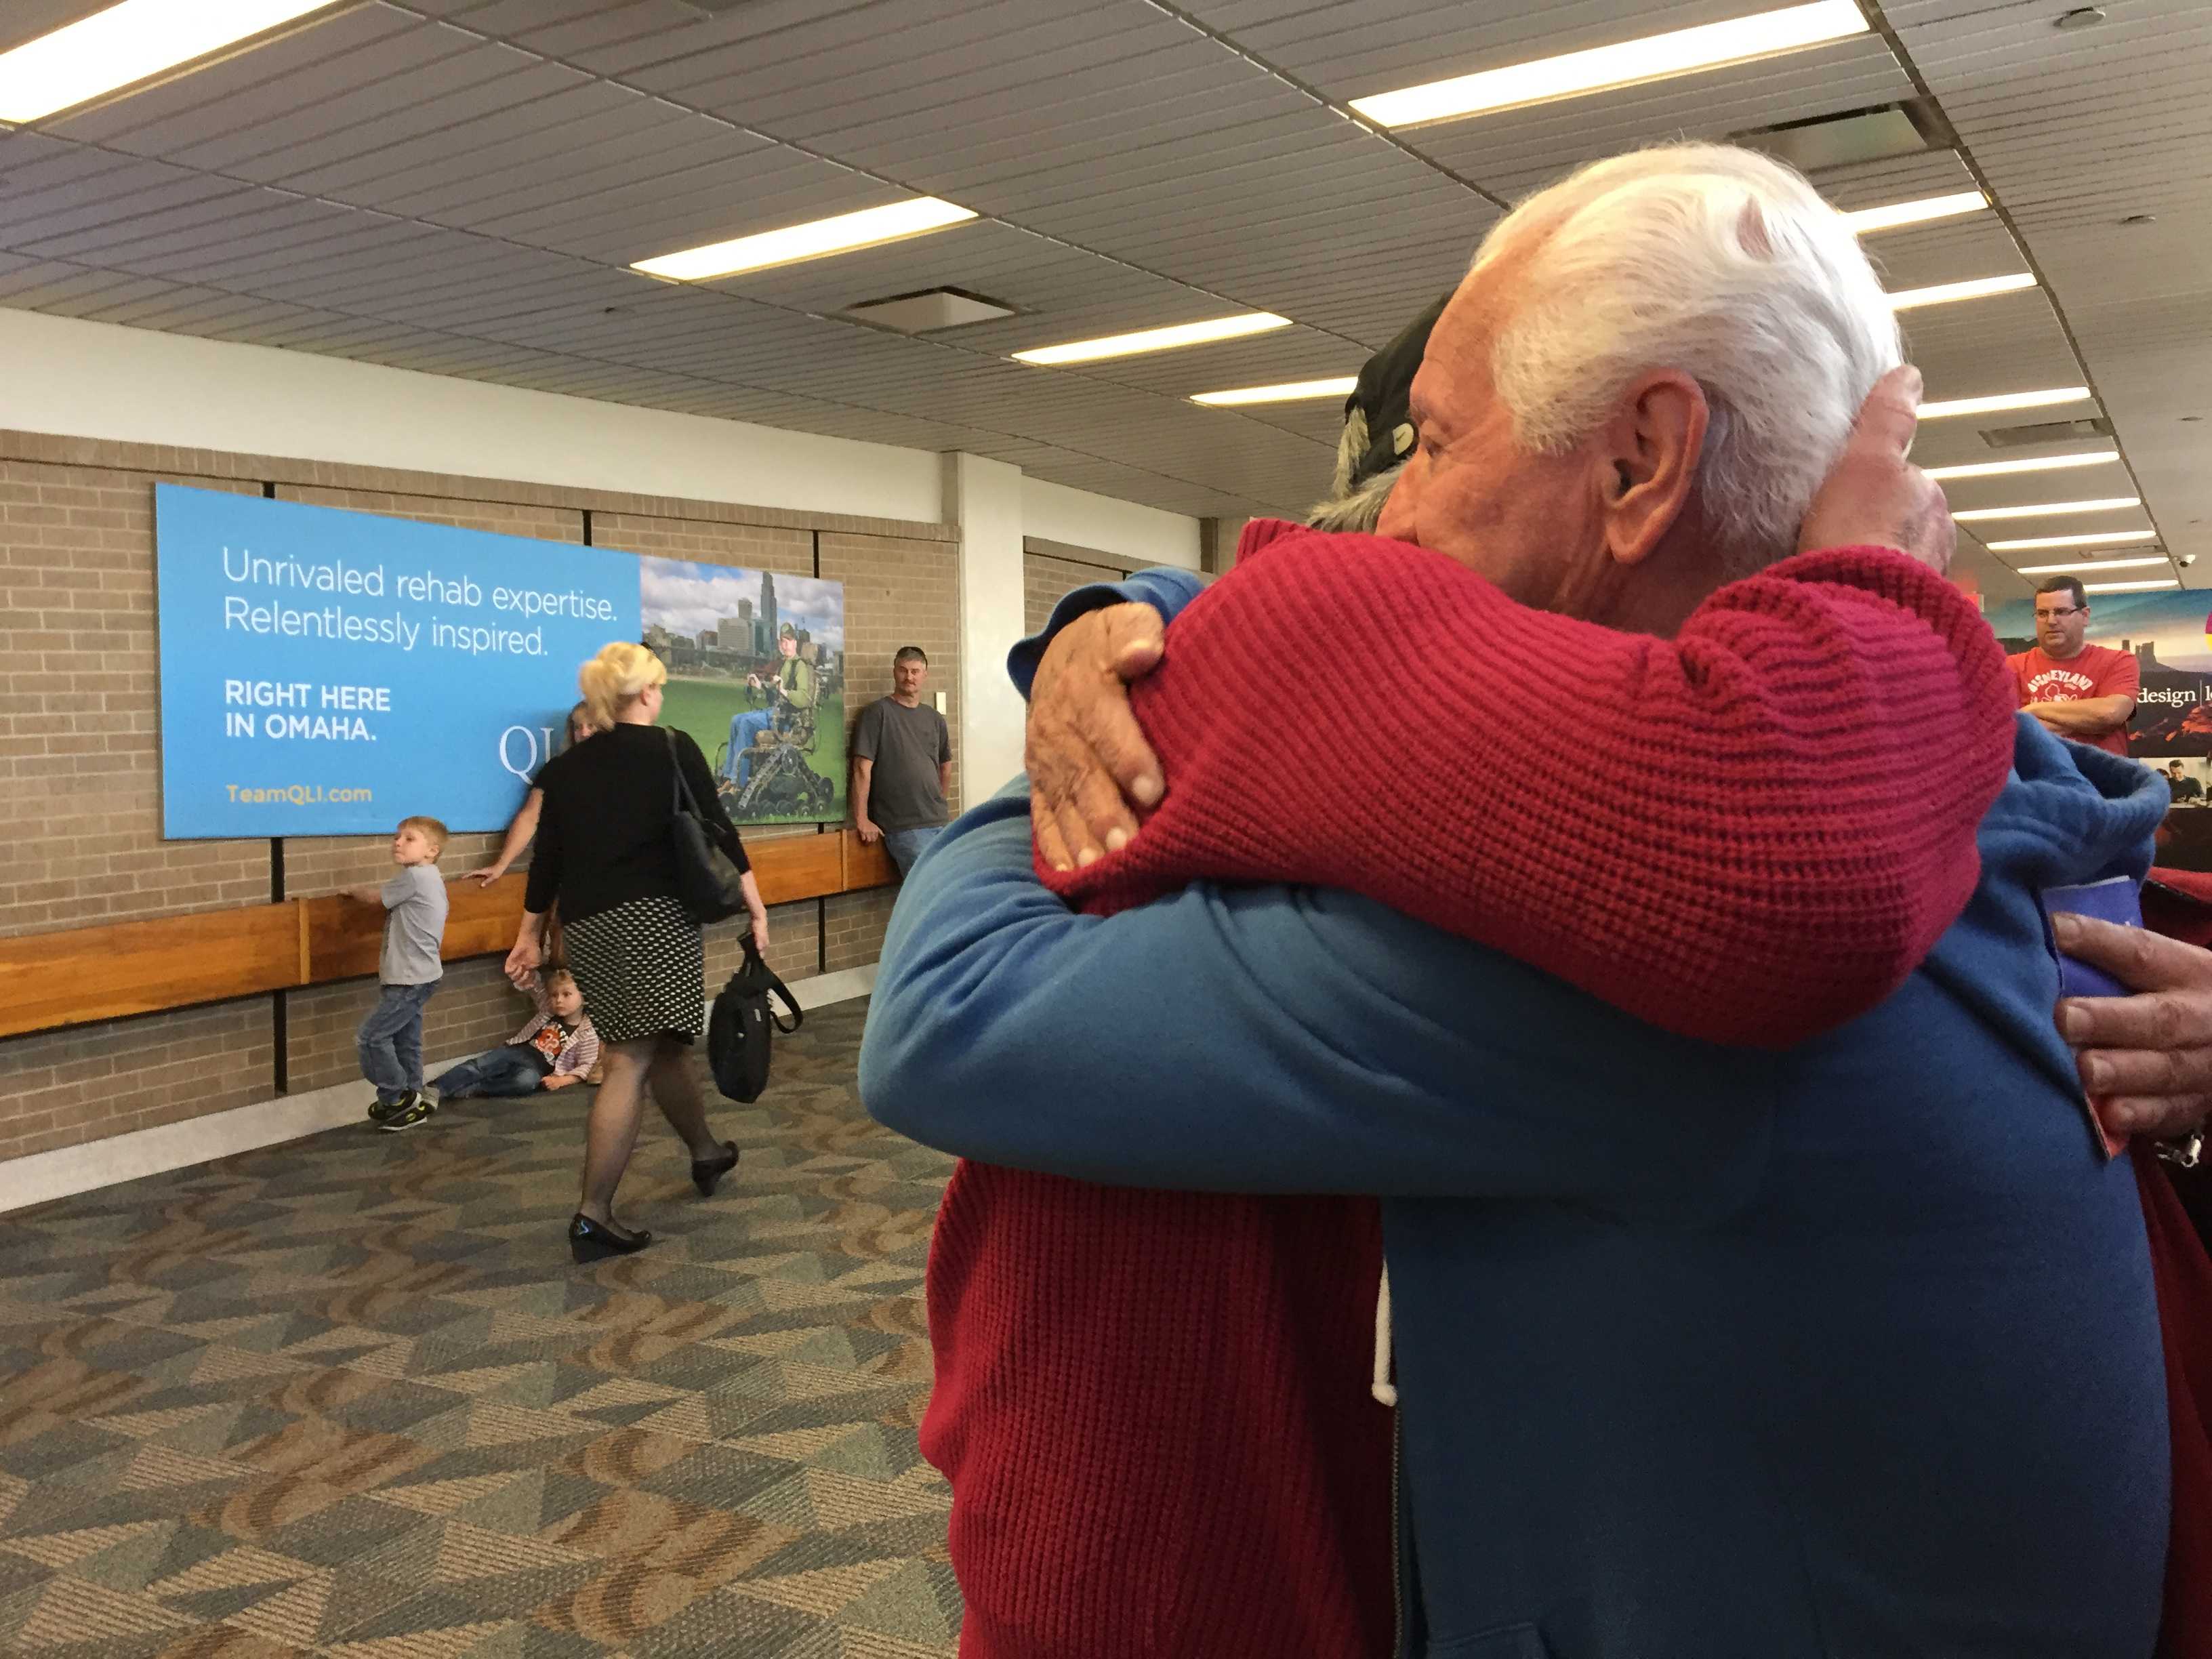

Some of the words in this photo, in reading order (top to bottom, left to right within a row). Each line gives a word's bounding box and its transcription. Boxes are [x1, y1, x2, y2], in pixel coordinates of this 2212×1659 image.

[223, 546, 384, 597] Unrivaled
[398, 570, 482, 607] rehab
[492, 586, 617, 621] expertise.
[224, 596, 420, 651] Relentlessly
[432, 615, 548, 656] inspired.
[225, 679, 312, 708] RIGHT
[321, 684, 391, 712] HERE
[2027, 670, 2093, 693] DISNEYLAND
[2137, 687, 2197, 708] design
[226, 712, 255, 738] IN
[265, 713, 377, 741] OMAHA.
[226, 783, 373, 806] TeamQLI.com
